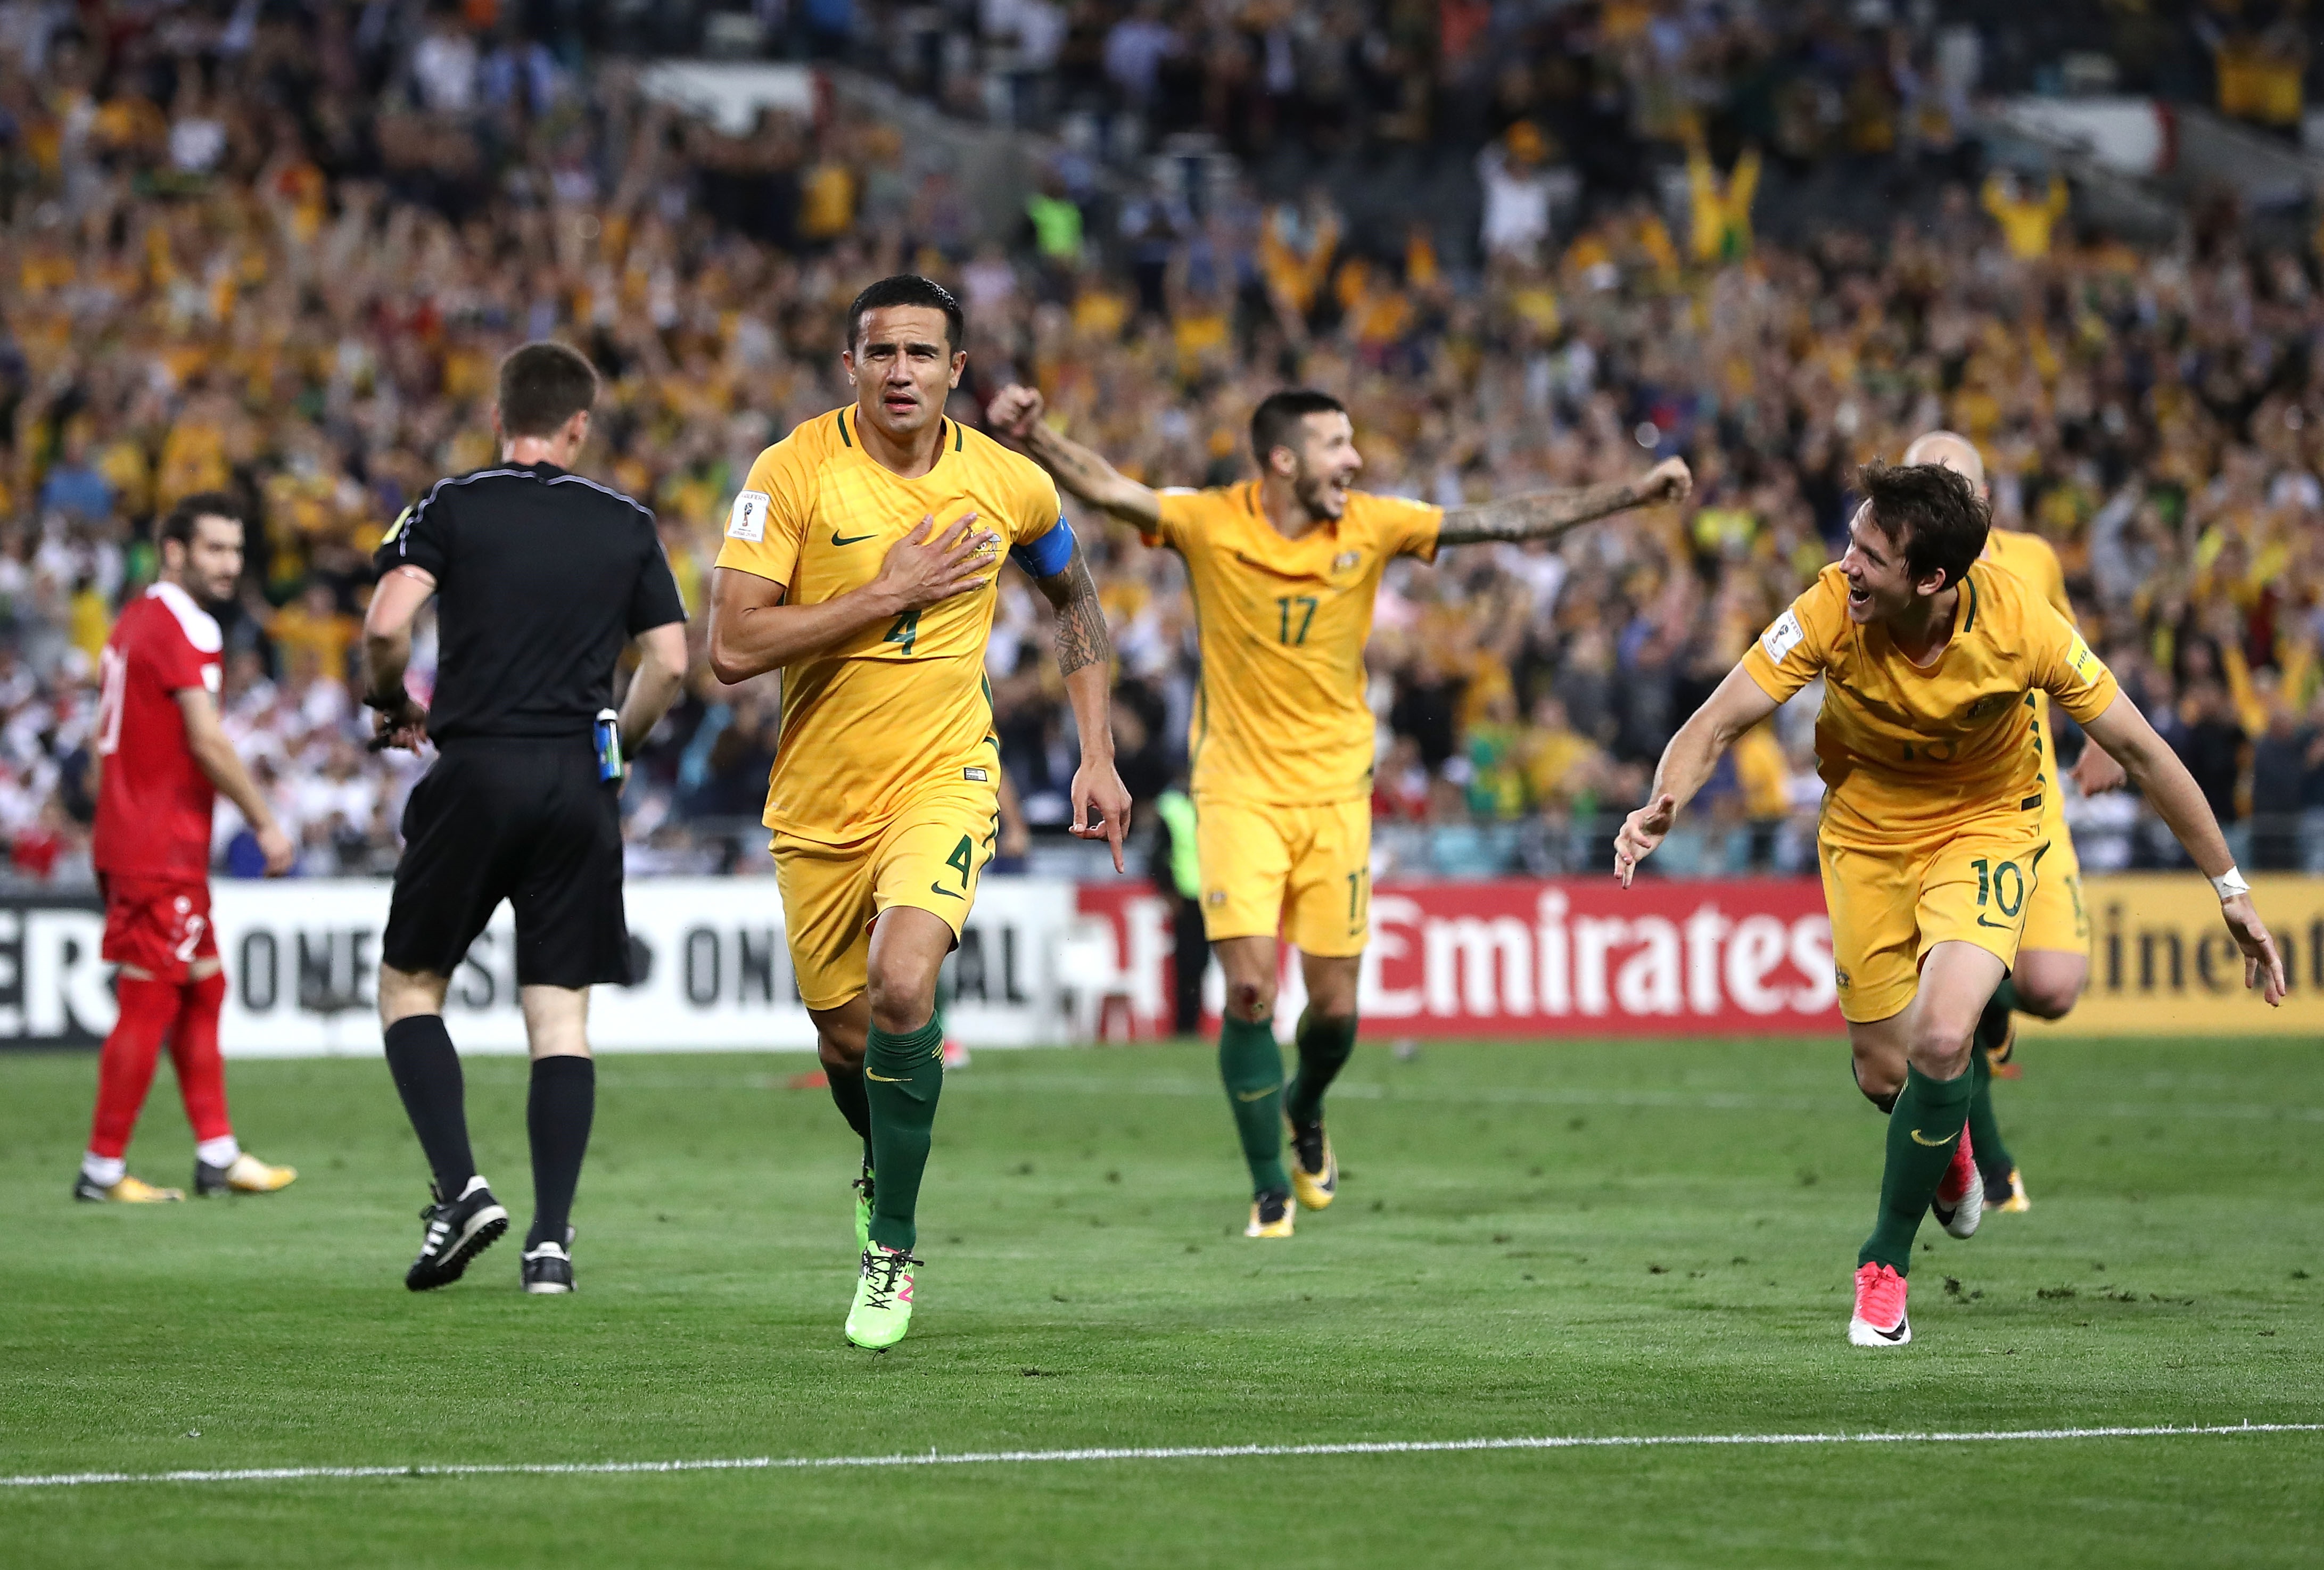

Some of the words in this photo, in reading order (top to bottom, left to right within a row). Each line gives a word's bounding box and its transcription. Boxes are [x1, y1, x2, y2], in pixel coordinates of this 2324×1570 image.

[883, 610, 922, 656] 4
[1276, 596, 1318, 646] 17
[2077, 649, 2087, 670] FIFA
[945, 834, 972, 890] 4
[1971, 858, 2025, 917] 10
[240, 927, 375, 1010] ONE
[686, 926, 803, 1005] ON
[956, 925, 1030, 1003] AL
[1359, 889, 1836, 1015] Emirates
